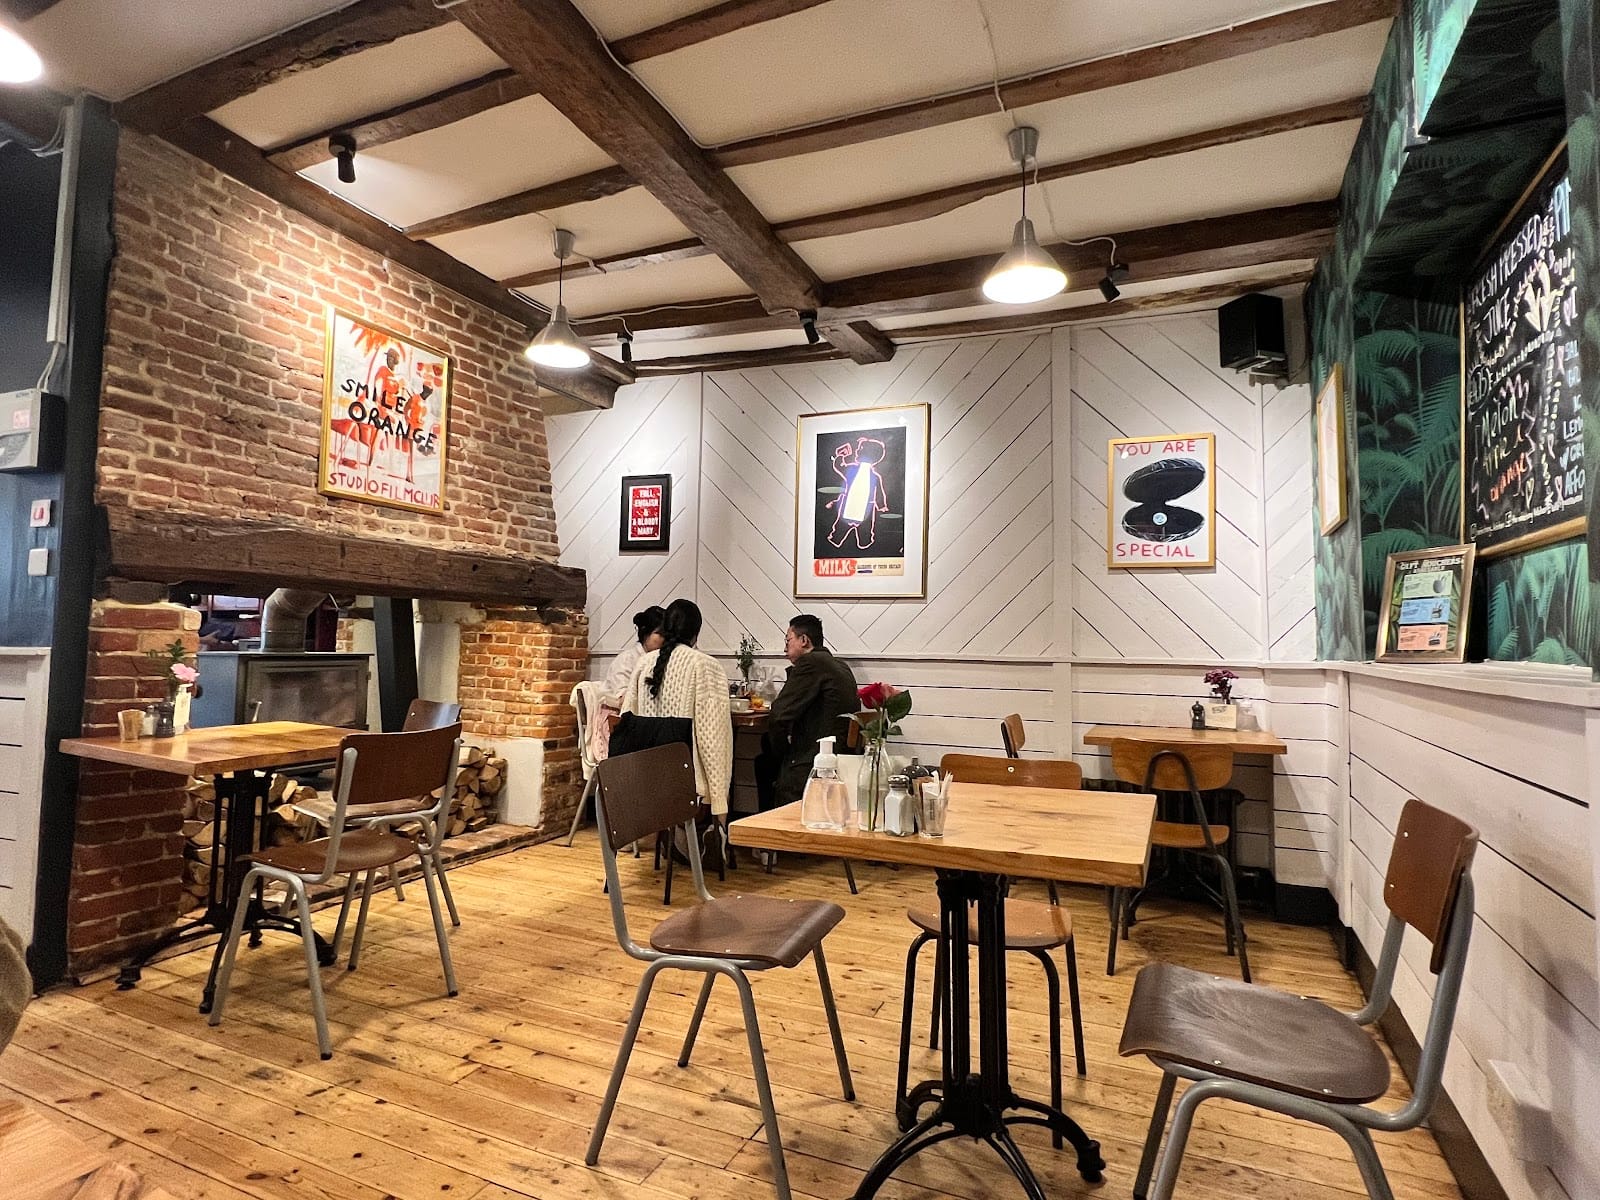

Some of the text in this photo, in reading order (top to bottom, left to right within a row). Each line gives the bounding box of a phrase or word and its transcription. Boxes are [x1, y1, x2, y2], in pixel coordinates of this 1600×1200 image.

[1500, 214, 1542, 286] PRESSED
[1483, 287, 1512, 343] JUICE
[341, 378, 406, 414] SMILE
[348, 401, 438, 448] ORANGE
[1116, 440, 1196, 457] YOU ARE
[637, 517, 659, 526] BLOODY
[1116, 543, 1195, 557] SPECIAL
[818, 559, 851, 575] MILK
